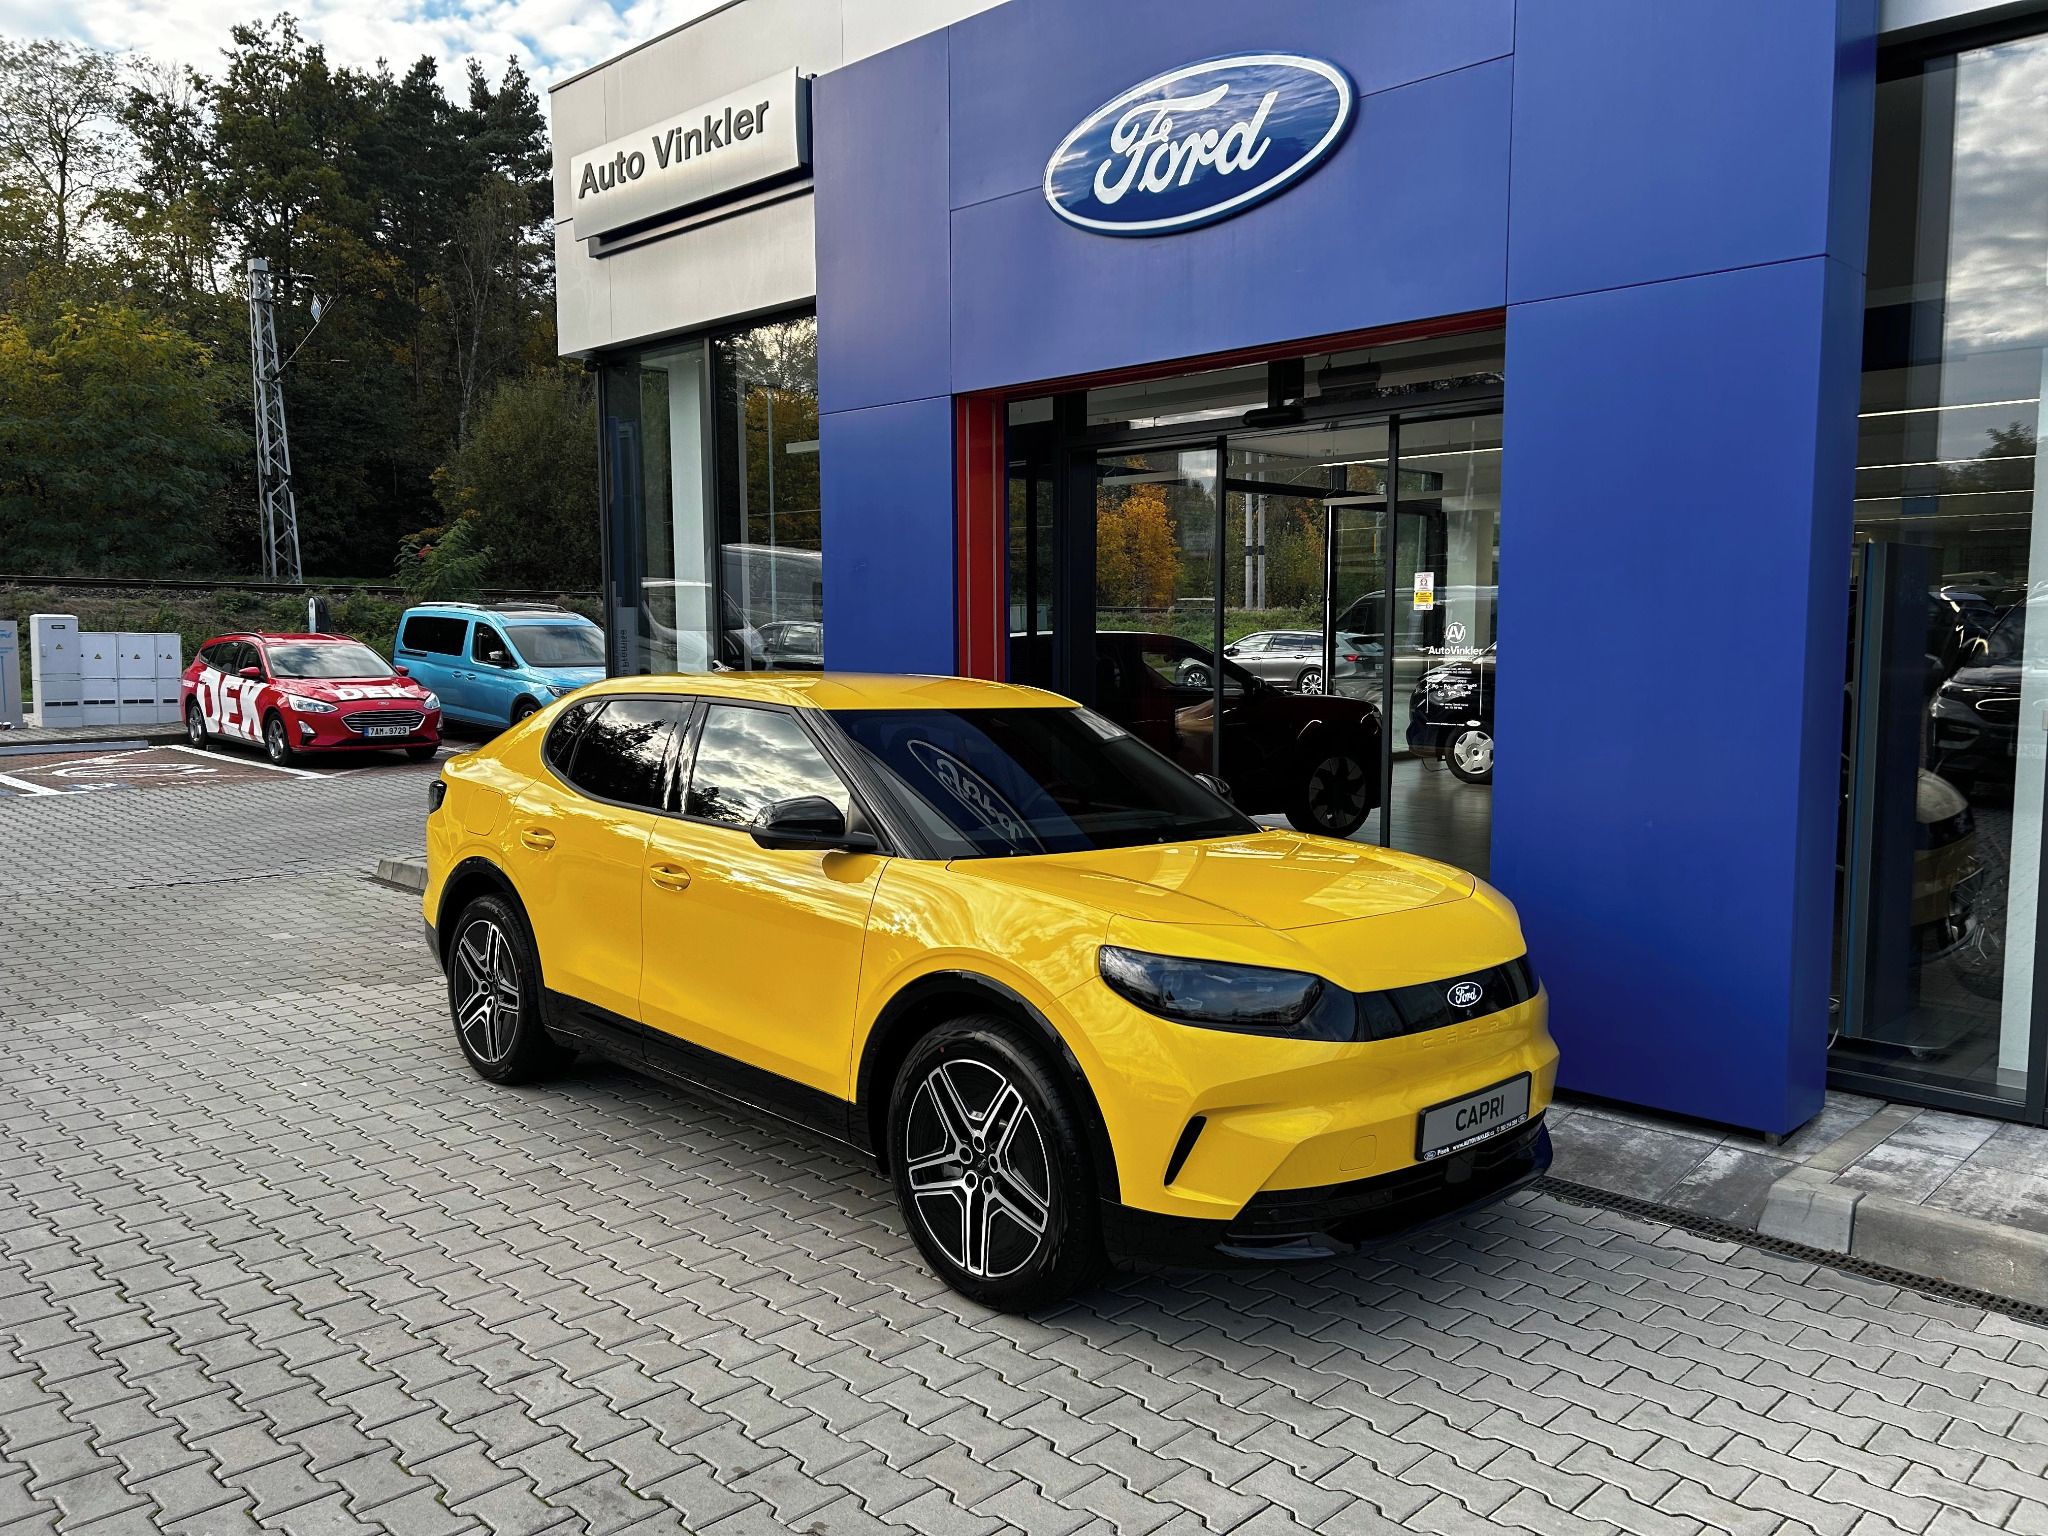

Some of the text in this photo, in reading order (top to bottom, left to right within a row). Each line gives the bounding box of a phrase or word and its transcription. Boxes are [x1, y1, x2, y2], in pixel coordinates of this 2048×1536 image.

[578, 100, 769, 199] Auto Vinkler
[1093, 83, 1279, 205] Ford
[1428, 646, 1483, 655] AutoVinkler
[197, 667, 271, 744] DEK
[334, 686, 418, 700] DEK
[370, 727, 384, 736] 7AM
[1455, 985, 1477, 1004] Ford
[1455, 1094, 1505, 1131] CAPRI
